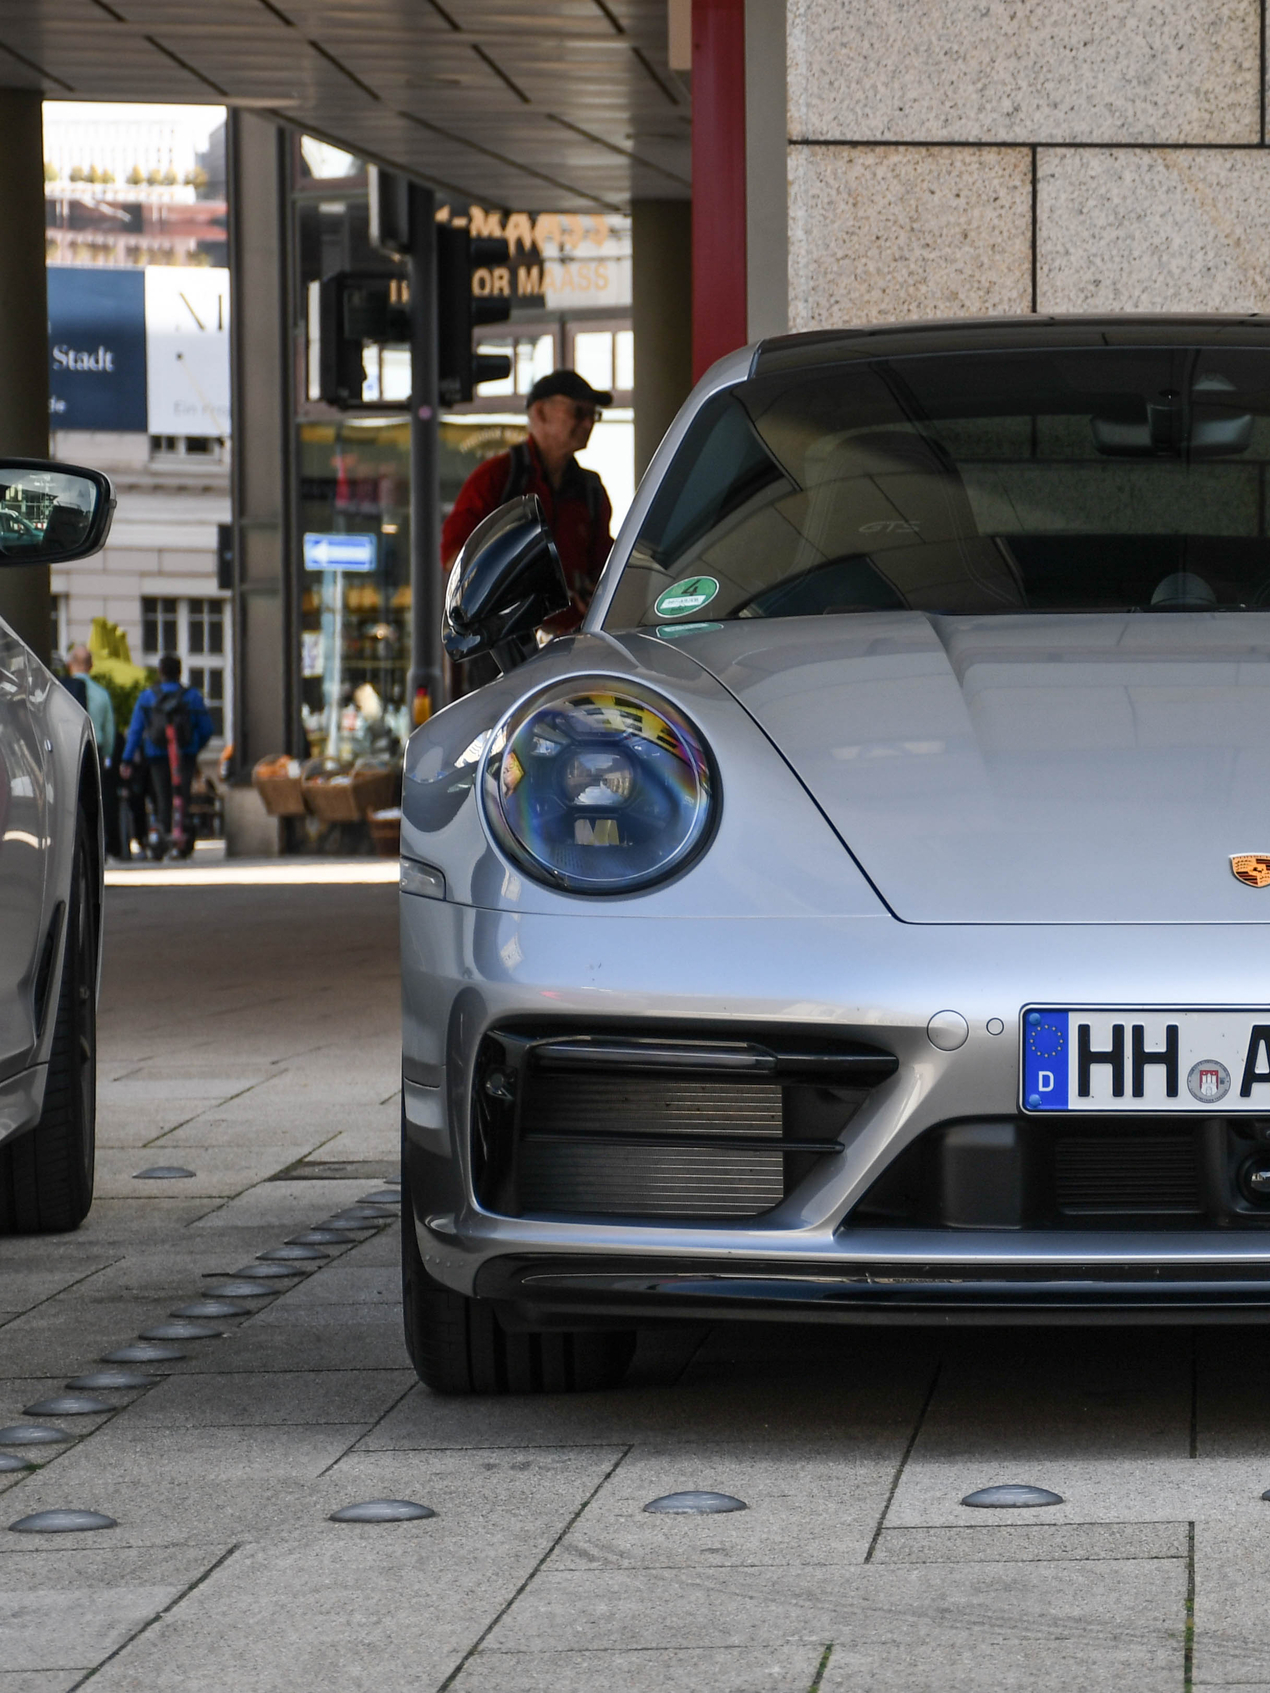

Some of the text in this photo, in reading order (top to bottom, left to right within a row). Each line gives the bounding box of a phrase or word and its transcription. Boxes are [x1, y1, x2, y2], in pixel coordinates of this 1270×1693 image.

[472, 264, 609, 298] OR MAASS
[52, 345, 116, 372] Stadt
[859, 520, 921, 533] GTS
[681, 579, 702, 596] 4
[1077, 1024, 1179, 1098] HH
[1038, 1071, 1055, 1092] D
